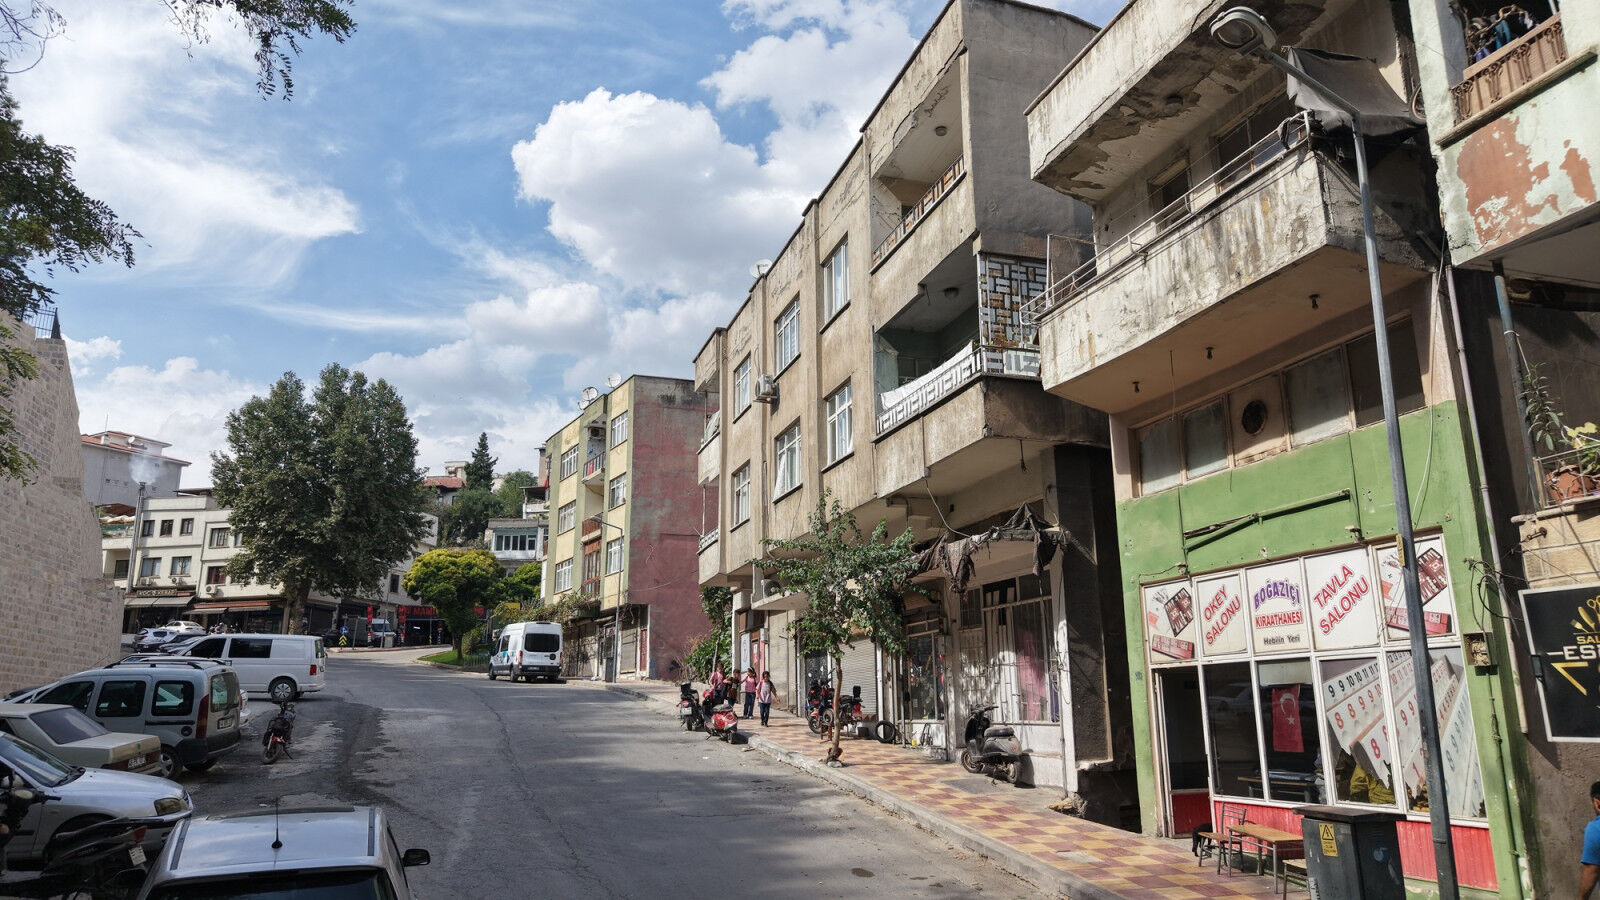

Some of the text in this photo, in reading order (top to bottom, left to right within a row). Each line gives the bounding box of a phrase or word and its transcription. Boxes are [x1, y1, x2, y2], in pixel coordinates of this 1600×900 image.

[1204, 584, 1228, 621] OKEY
[1254, 579, 1301, 610] BOĞAZİÇİ
[1313, 565, 1353, 608] TAVLA
[1205, 595, 1241, 645] SALONU
[1320, 577, 1369, 634] SALONU
[1563, 645, 1600, 661] ES
[1334, 711, 1344, 729] 8
[1347, 703, 1356, 719] 8
[1370, 738, 1381, 760] 8
